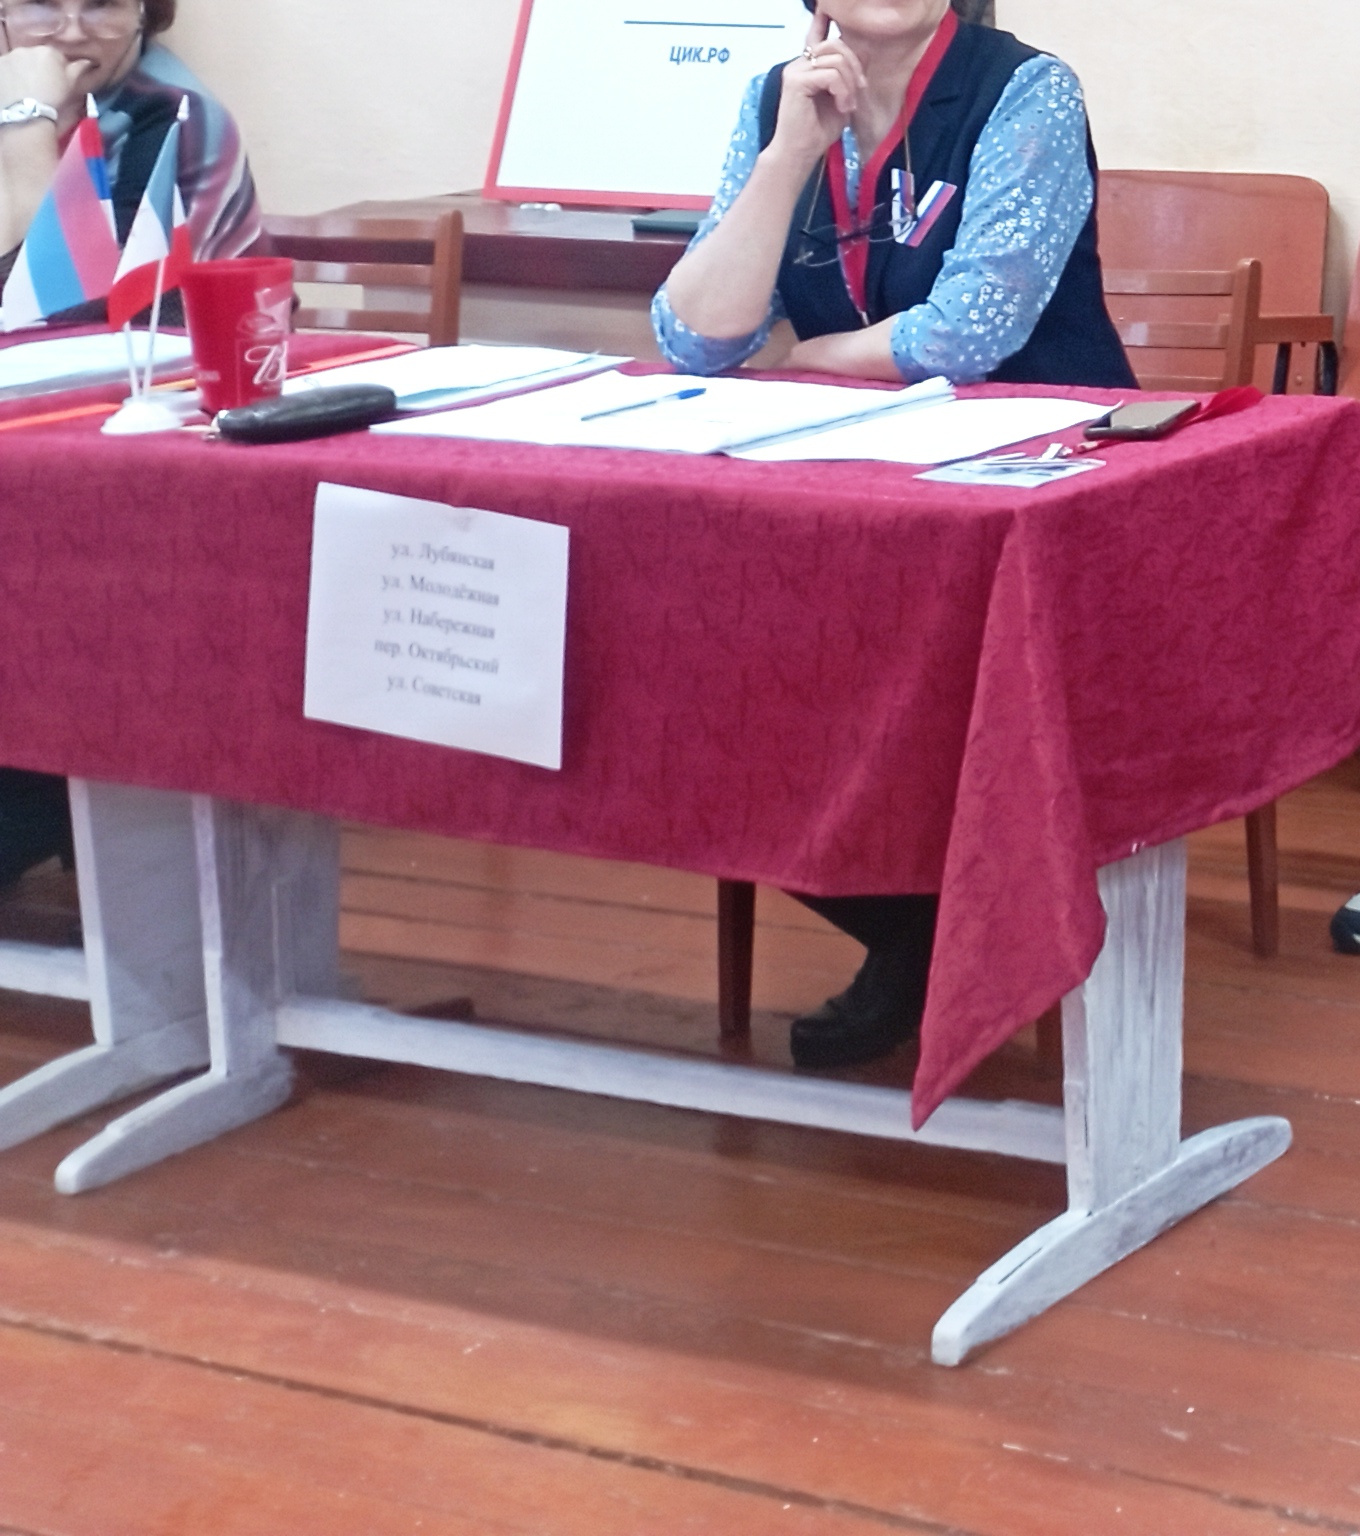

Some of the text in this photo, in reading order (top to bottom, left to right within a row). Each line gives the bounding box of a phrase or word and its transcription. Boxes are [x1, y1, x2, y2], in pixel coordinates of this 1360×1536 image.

[669, 45, 731, 66] ЦИК.РФ
[390, 543, 415, 560] ул.
[381, 574, 405, 592] ул.
[382, 607, 496, 639] ул. Набережная
[374, 639, 500, 675] пер. Октябрьский
[386, 675, 481, 706] ул. Советская
